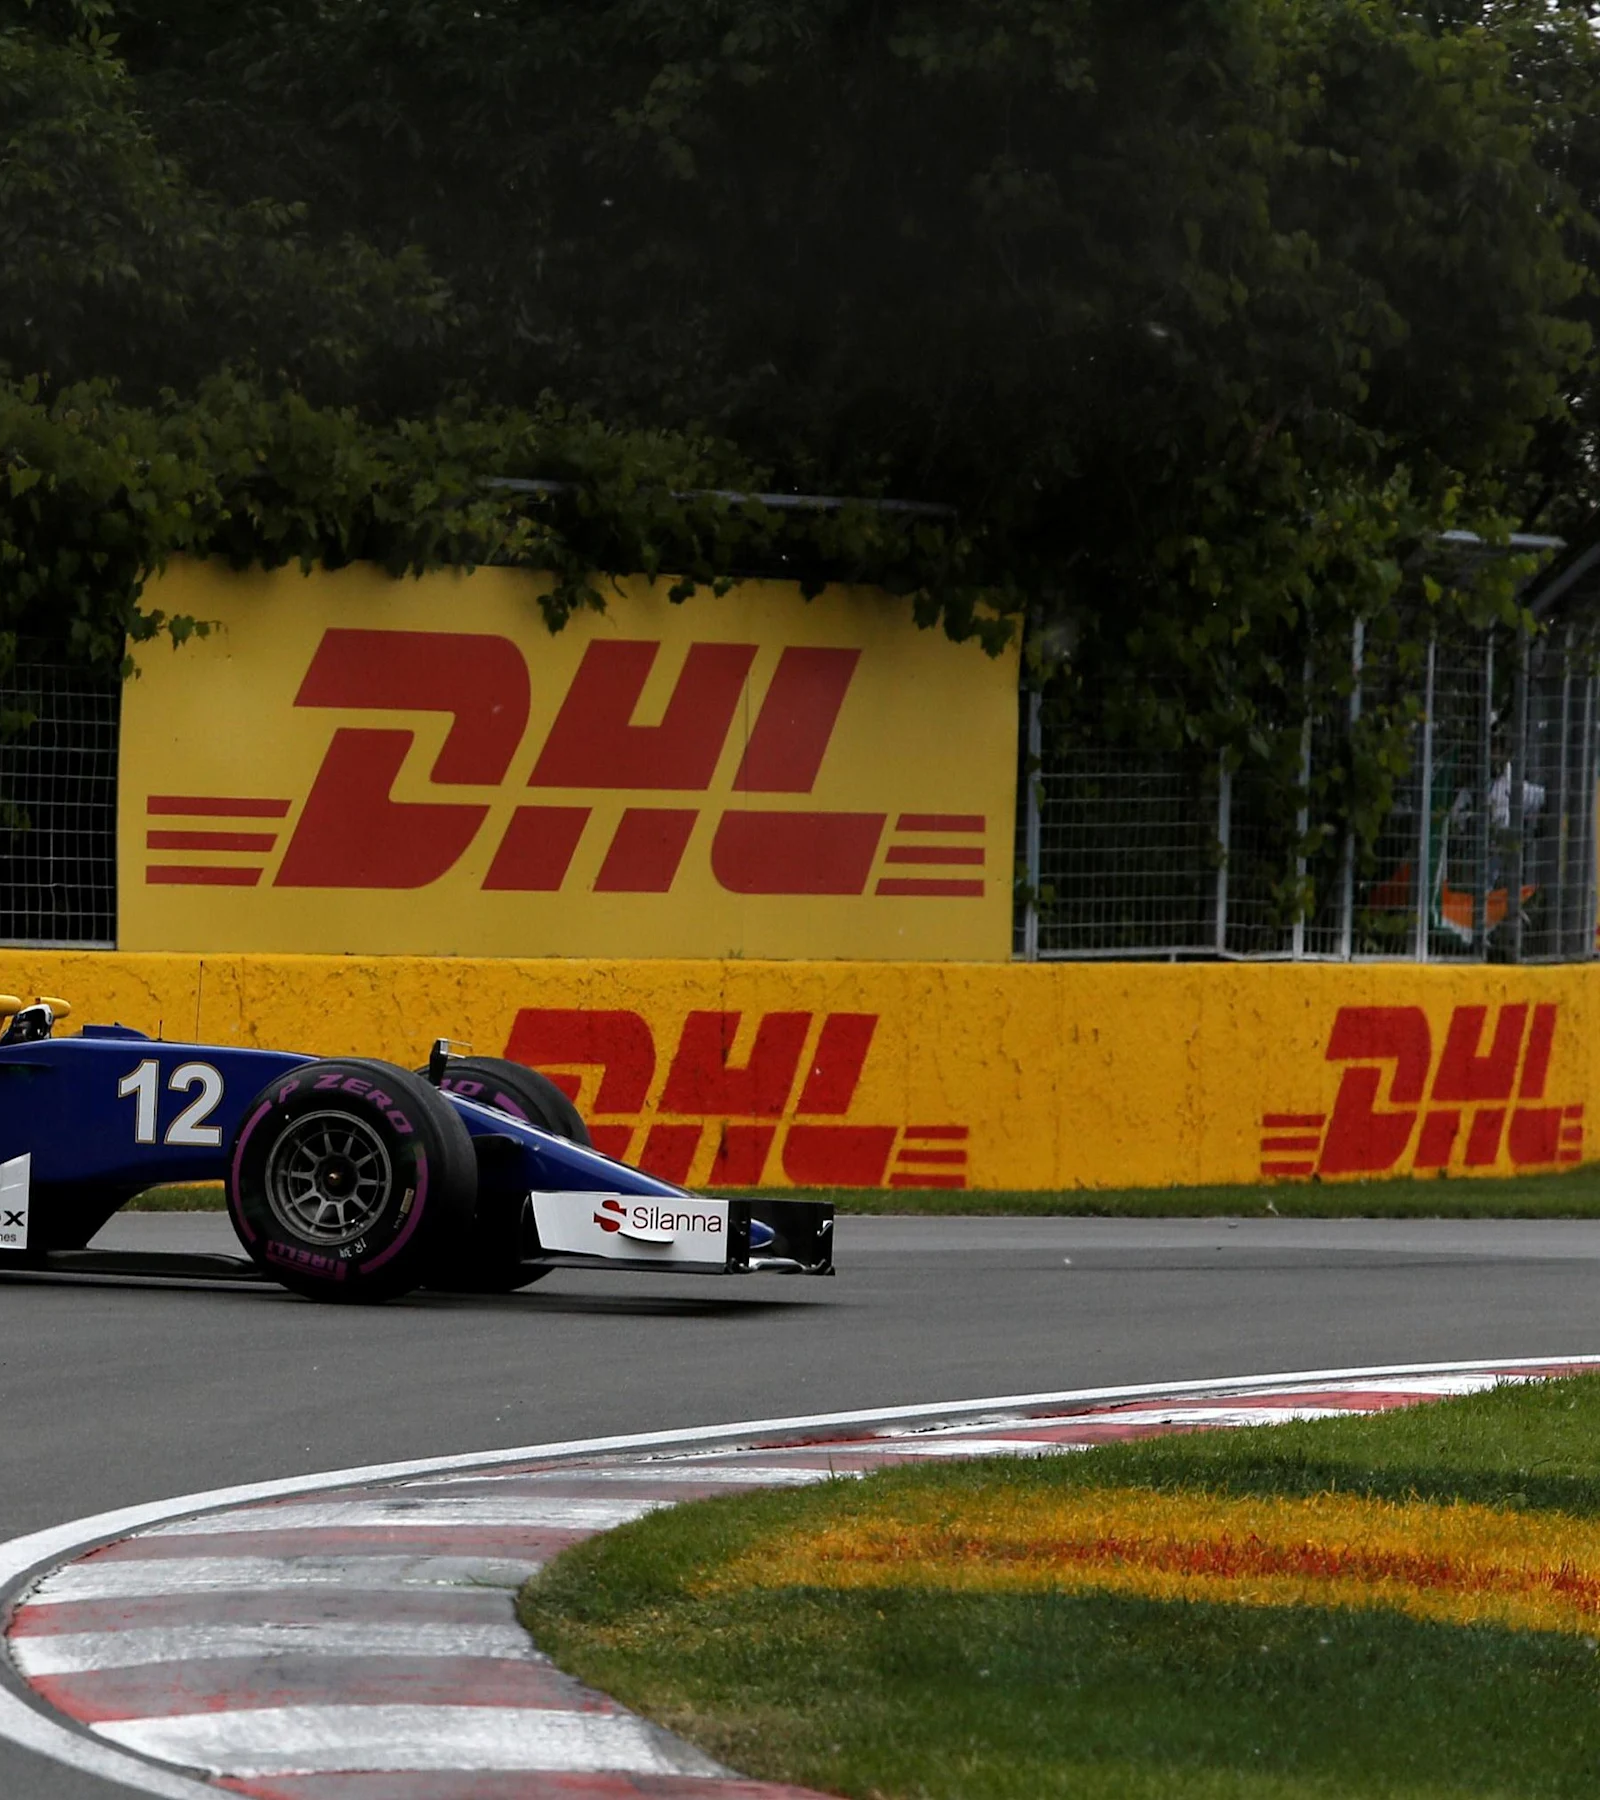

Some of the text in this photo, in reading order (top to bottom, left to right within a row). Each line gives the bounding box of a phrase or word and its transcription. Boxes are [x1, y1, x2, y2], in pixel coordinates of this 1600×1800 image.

[271, 628, 888, 896] DHL
[118, 1059, 224, 1147] 12
[279, 1080, 300, 1104] P
[313, 1074, 414, 1134] ZERO
[503, 1007, 898, 1186] DHL
[1316, 1003, 1568, 1173] DHL
[632, 1206, 722, 1233] Silanna
